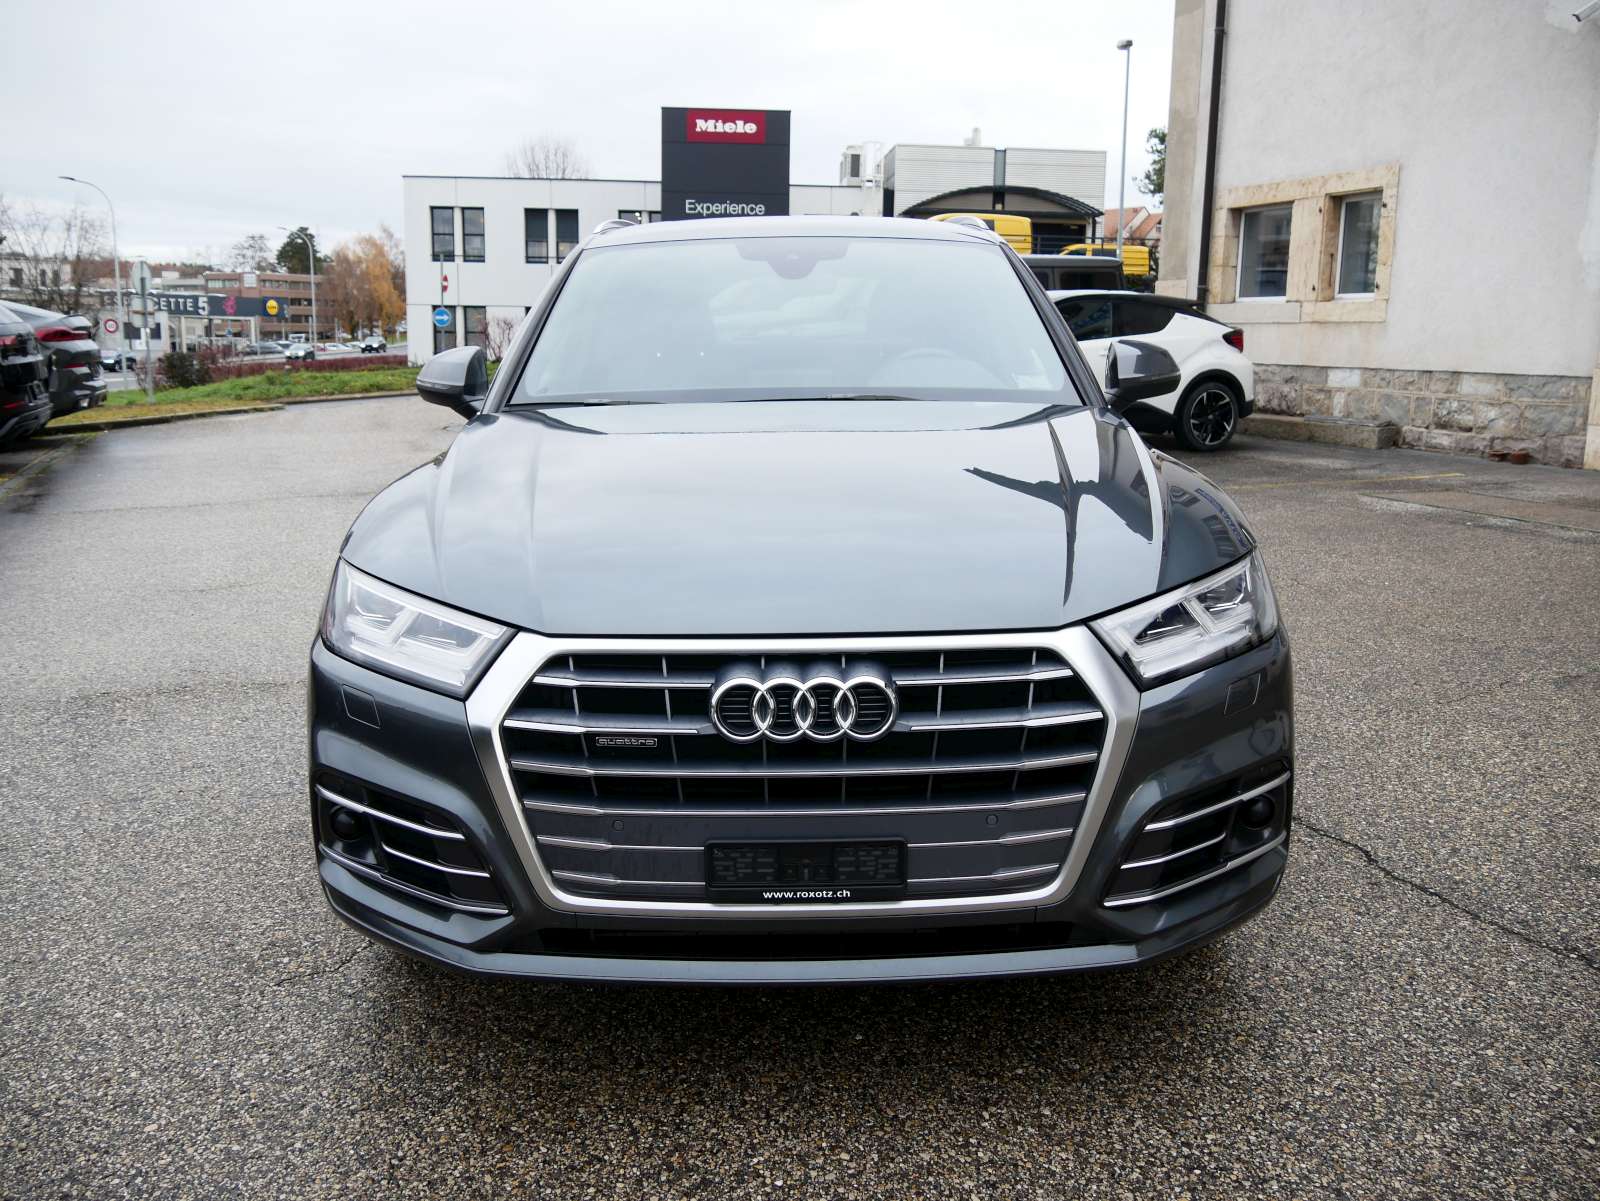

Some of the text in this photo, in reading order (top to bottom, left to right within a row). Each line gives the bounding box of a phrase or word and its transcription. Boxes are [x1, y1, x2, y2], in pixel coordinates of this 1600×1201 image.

[695, 119, 757, 133] Miele
[686, 199, 765, 216] Experience
[198, 296, 208, 315] 5
[597, 738, 656, 747] quattro
[762, 889, 851, 899] www.roxotz.ch
